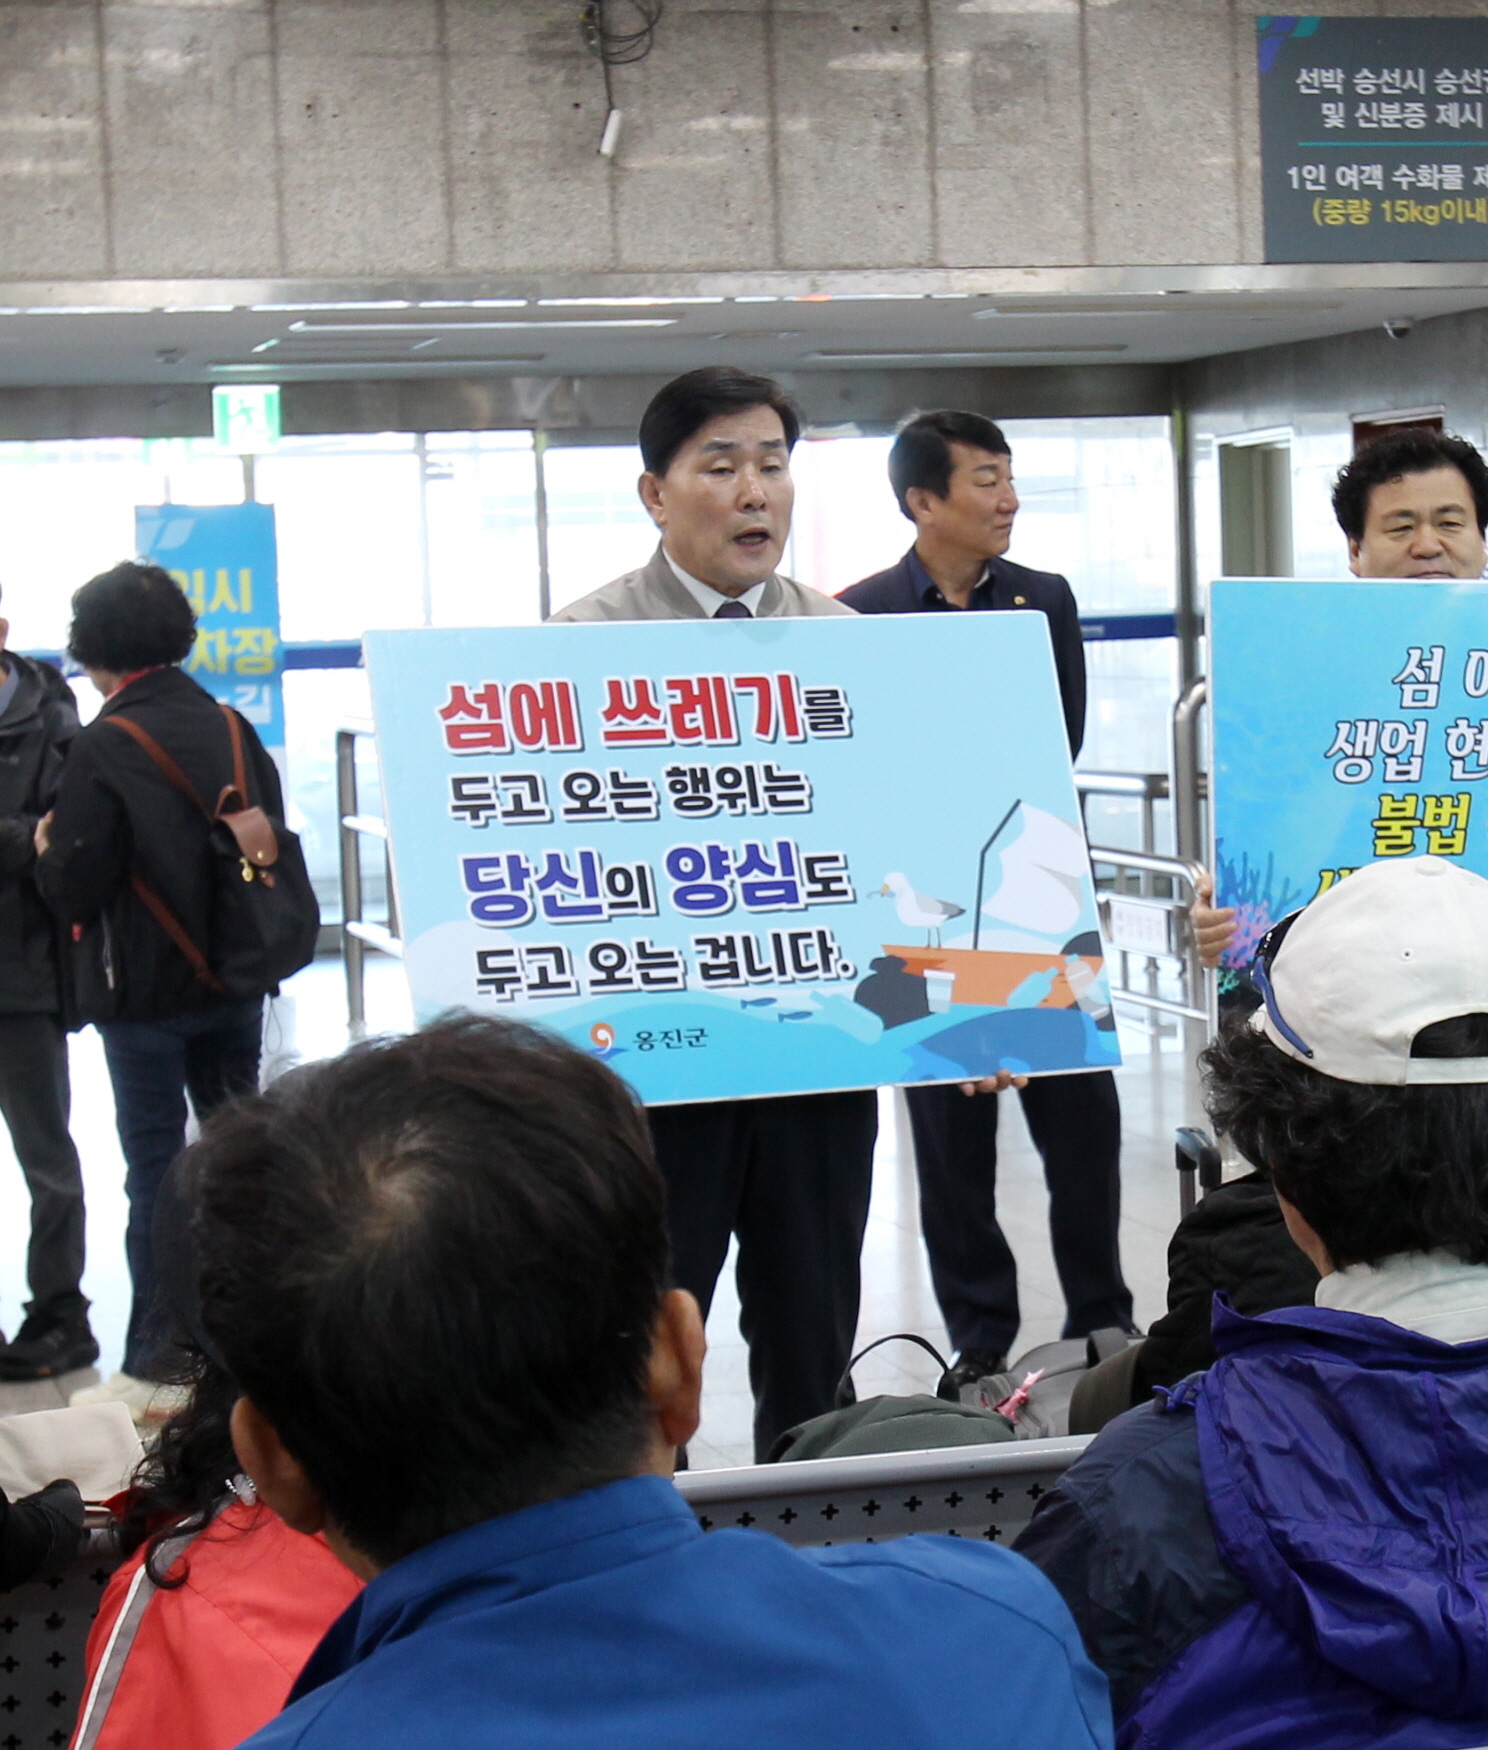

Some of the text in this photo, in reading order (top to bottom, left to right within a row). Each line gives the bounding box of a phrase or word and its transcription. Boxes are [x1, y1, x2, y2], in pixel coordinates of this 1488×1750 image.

[1296, 68, 1344, 94] 선박
[1353, 68, 1426, 95] 승선시
[1322, 102, 1484, 129] 및 신분증 제시
[1287, 164, 1326, 190] 1인
[1335, 164, 1384, 190] 여객
[1392, 164, 1463, 190] 수화물
[1312, 197, 1371, 226] (중량
[188, 627, 279, 676] 차장
[1393, 647, 1444, 709] 섬
[437, 674, 851, 751] 섬에 쓰레기를
[1326, 719, 1427, 782] 생업
[450, 763, 812, 824] 두고 오는 행위는
[1371, 794, 1471, 856] 불법
[461, 840, 853, 924] 당신의 양심도
[475, 931, 857, 998] 두고 오는 겁니다.
[632, 1028, 709, 1052] 옹진군
